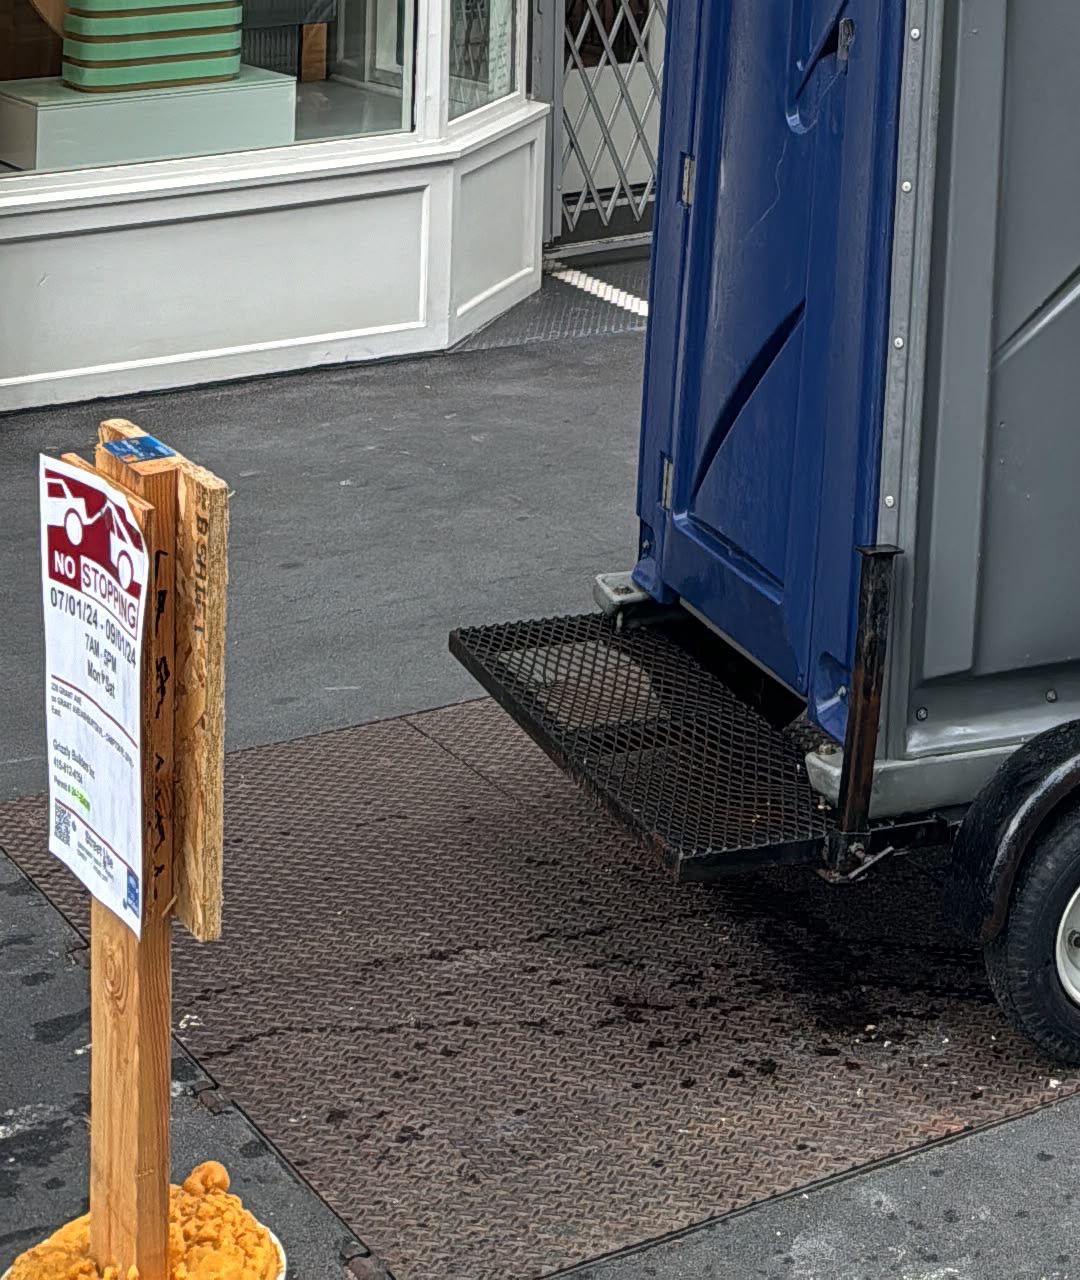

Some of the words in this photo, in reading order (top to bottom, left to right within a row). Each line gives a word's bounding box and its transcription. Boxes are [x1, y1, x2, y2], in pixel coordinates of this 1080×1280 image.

[50, 586, 98, 630] 07/01/24
[105, 618, 137, 670] 09/01/24
[54, 550, 76, 580] NO
[82, 562, 137, 630] STOPPING
[84, 632, 100, 659] 7AM
